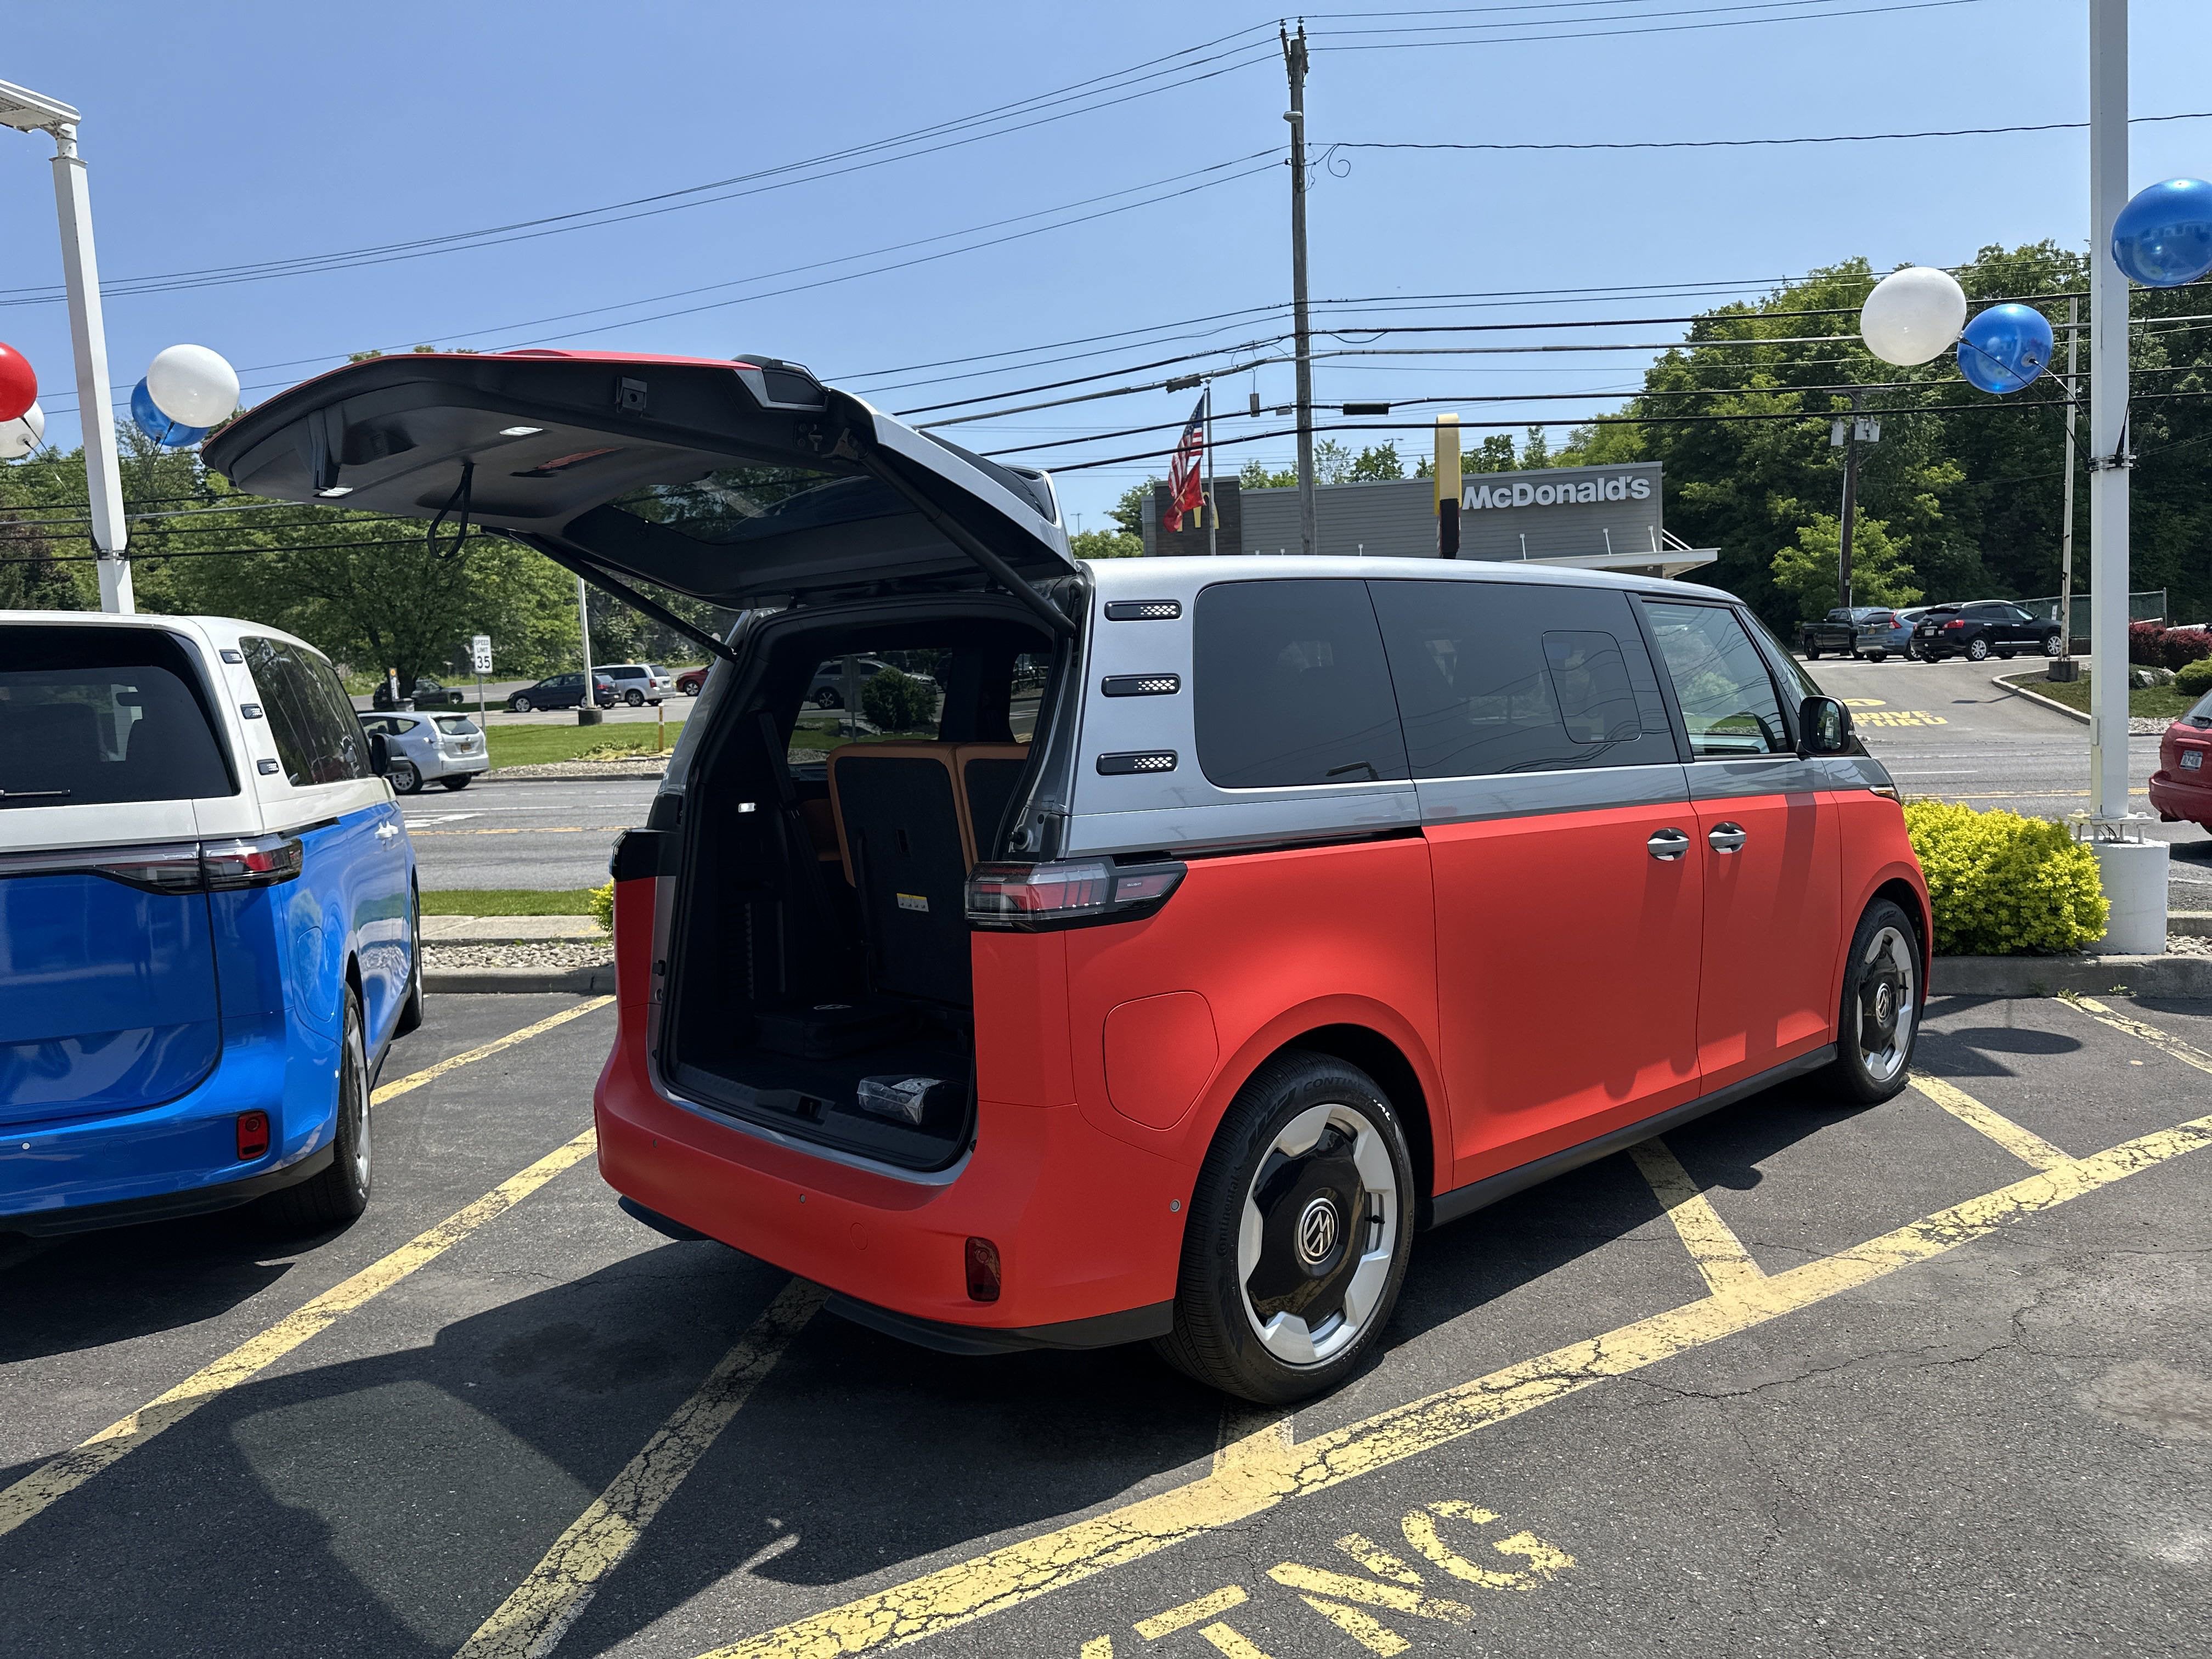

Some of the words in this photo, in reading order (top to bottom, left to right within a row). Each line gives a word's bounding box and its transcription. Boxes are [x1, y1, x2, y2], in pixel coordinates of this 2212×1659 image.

[1462, 476, 1650, 510] McDonald's
[477, 656, 490, 669] 35
[1853, 716, 1949, 727] THRU
[1217, 1175, 1239, 1257] Continental
